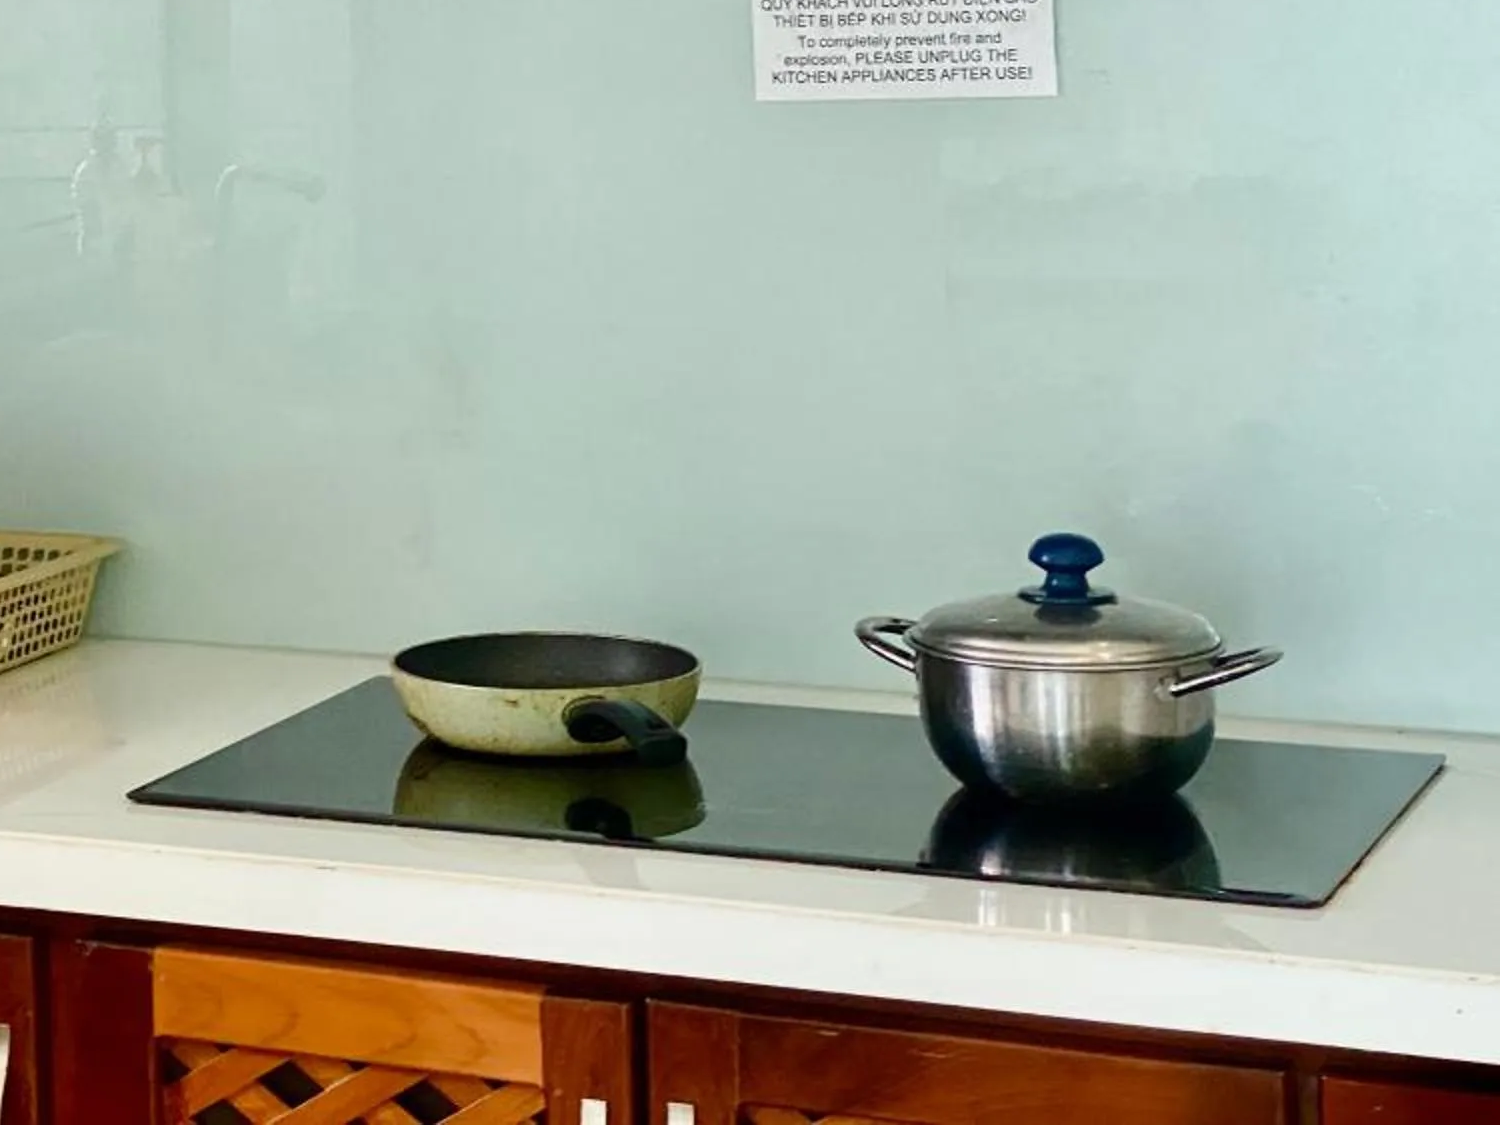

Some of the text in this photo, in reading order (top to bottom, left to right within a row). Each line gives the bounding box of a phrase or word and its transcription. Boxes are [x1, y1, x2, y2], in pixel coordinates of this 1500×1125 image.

[871, 12, 897, 25] KHI
[798, 32, 1002, 49] To completely prevent fire and
[855, 50, 913, 65] PLEASE
[918, 48, 982, 64] UNPLUG
[987, 48, 1019, 62] THE
[772, 65, 1033, 84] KITCHEN APPLIANCES AFTER USE!
